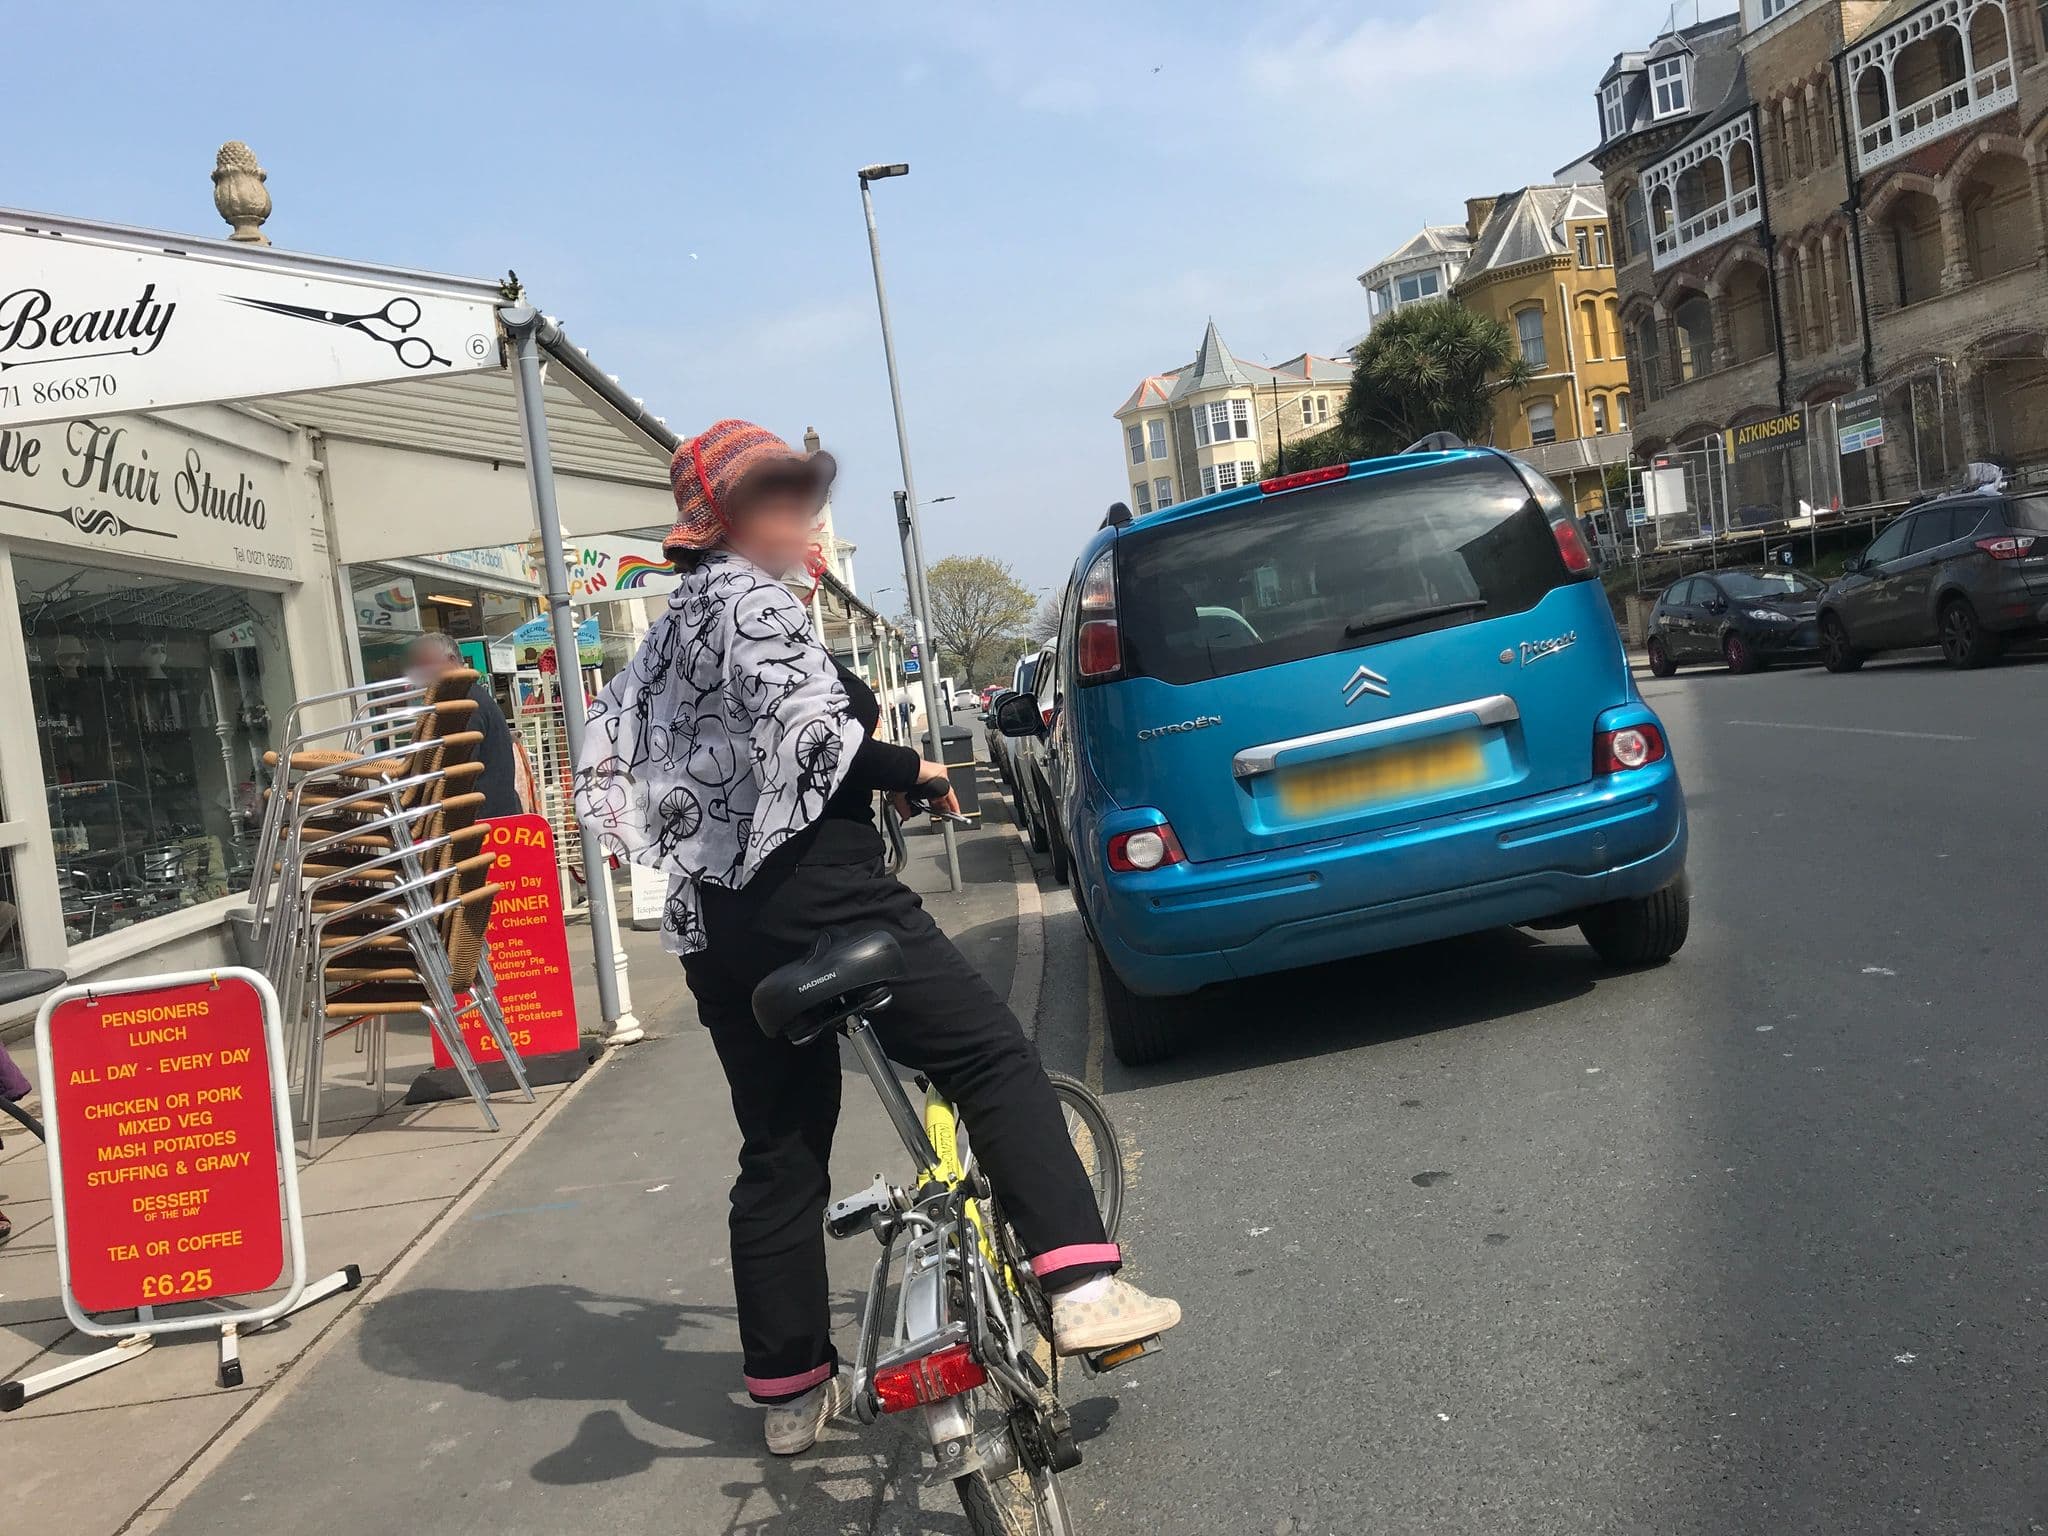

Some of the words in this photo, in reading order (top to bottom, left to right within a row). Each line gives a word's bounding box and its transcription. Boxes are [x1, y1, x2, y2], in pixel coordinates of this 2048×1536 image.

[0, 283, 176, 355] Beauty
[472, 339, 484, 355] 6
[33, 374, 117, 404] 866870
[1739, 413, 1800, 445] ATKINSONS
[62, 420, 161, 505] Hair
[174, 448, 267, 530] Studio
[520, 626, 546, 638] BEECHDE
[1137, 715, 1222, 740] CITROËN
[521, 876, 542, 888] Day
[502, 915, 547, 928] Chicken
[498, 949, 532, 960] Onions
[508, 938, 524, 947] Pie
[493, 959, 526, 971] Kidney
[530, 957, 545, 965] Pie
[544, 966, 559, 974] Pie
[798, 971, 837, 993] MADISON
[502, 991, 537, 1003] served
[102, 1001, 209, 1028] PENSIONERS
[518, 1010, 563, 1022] Potatoes
[129, 1026, 187, 1047] LUNCH
[69, 1069, 101, 1085] ALL
[107, 1063, 138, 1080] DAY
[160, 1053, 213, 1073] EVERY
[221, 1048, 251, 1065] DAY
[84, 1097, 159, 1120] CHICKEN
[166, 1093, 190, 1109] OR
[197, 1086, 243, 1105] PORK
[118, 1116, 170, 1136] MIXED
[178, 1111, 213, 1128] VEG
[97, 1143, 146, 1162] MASH
[154, 1130, 236, 1154] POTATOES
[87, 1163, 168, 1187] STUFFING
[176, 1160, 188, 1175] &
[195, 1152, 251, 1171] GRAVY
[132, 1189, 209, 1213] DESSERT
[144, 1212, 158, 1222] OF
[160, 1210, 179, 1220] THE
[183, 1207, 201, 1217] DAY
[107, 1245, 139, 1261] TEA
[146, 1241, 170, 1257] OR
[178, 1230, 243, 1252] COFFEE
[142, 1268, 213, 1298] £6.25
